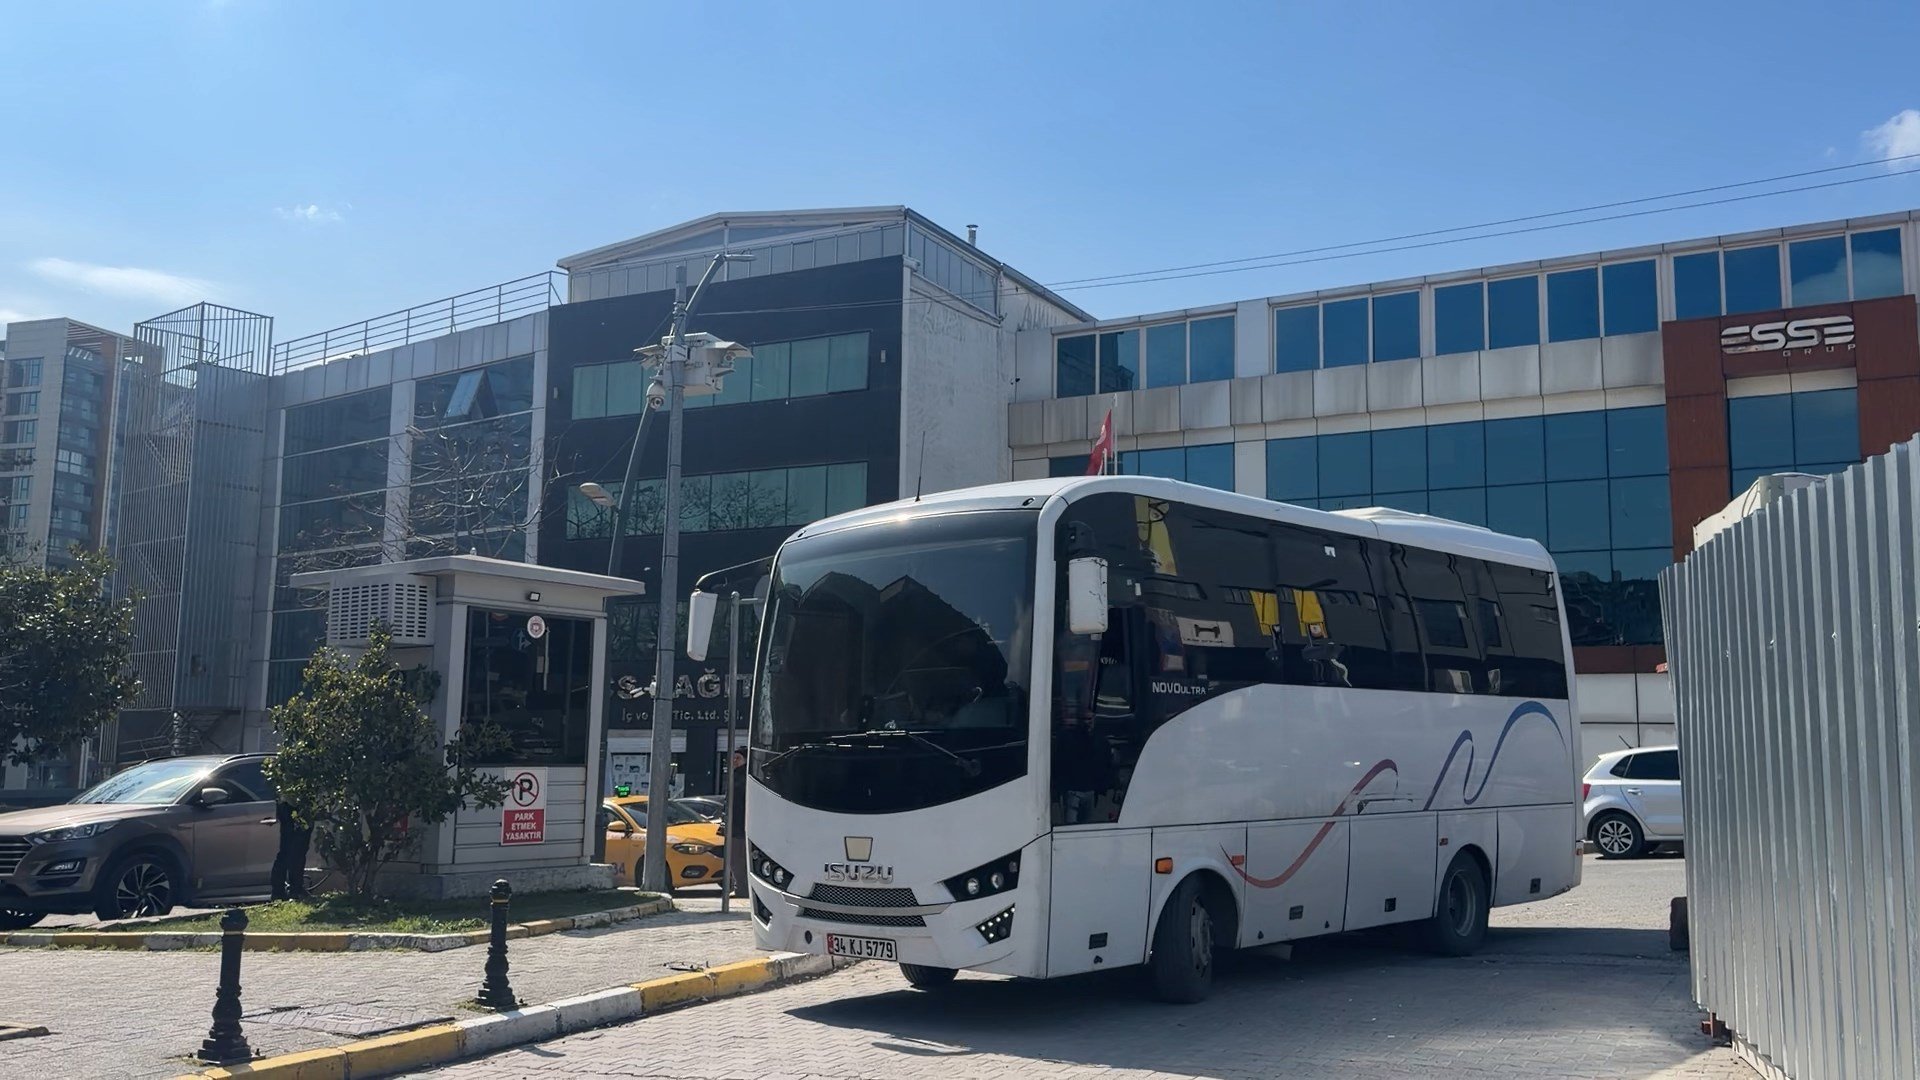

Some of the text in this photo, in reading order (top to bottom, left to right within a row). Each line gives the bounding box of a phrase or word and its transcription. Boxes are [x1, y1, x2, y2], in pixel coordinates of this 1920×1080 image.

[1783, 344, 1856, 357] GRUP
[698, 710, 719, 720] Ltd.
[514, 813, 534, 821] PARK
[511, 823, 537, 831] ETMEK
[505, 832, 542, 841] YASAKTIR
[824, 863, 893, 884] ISUZU
[834, 937, 893, 959] 34 KJ 5779
